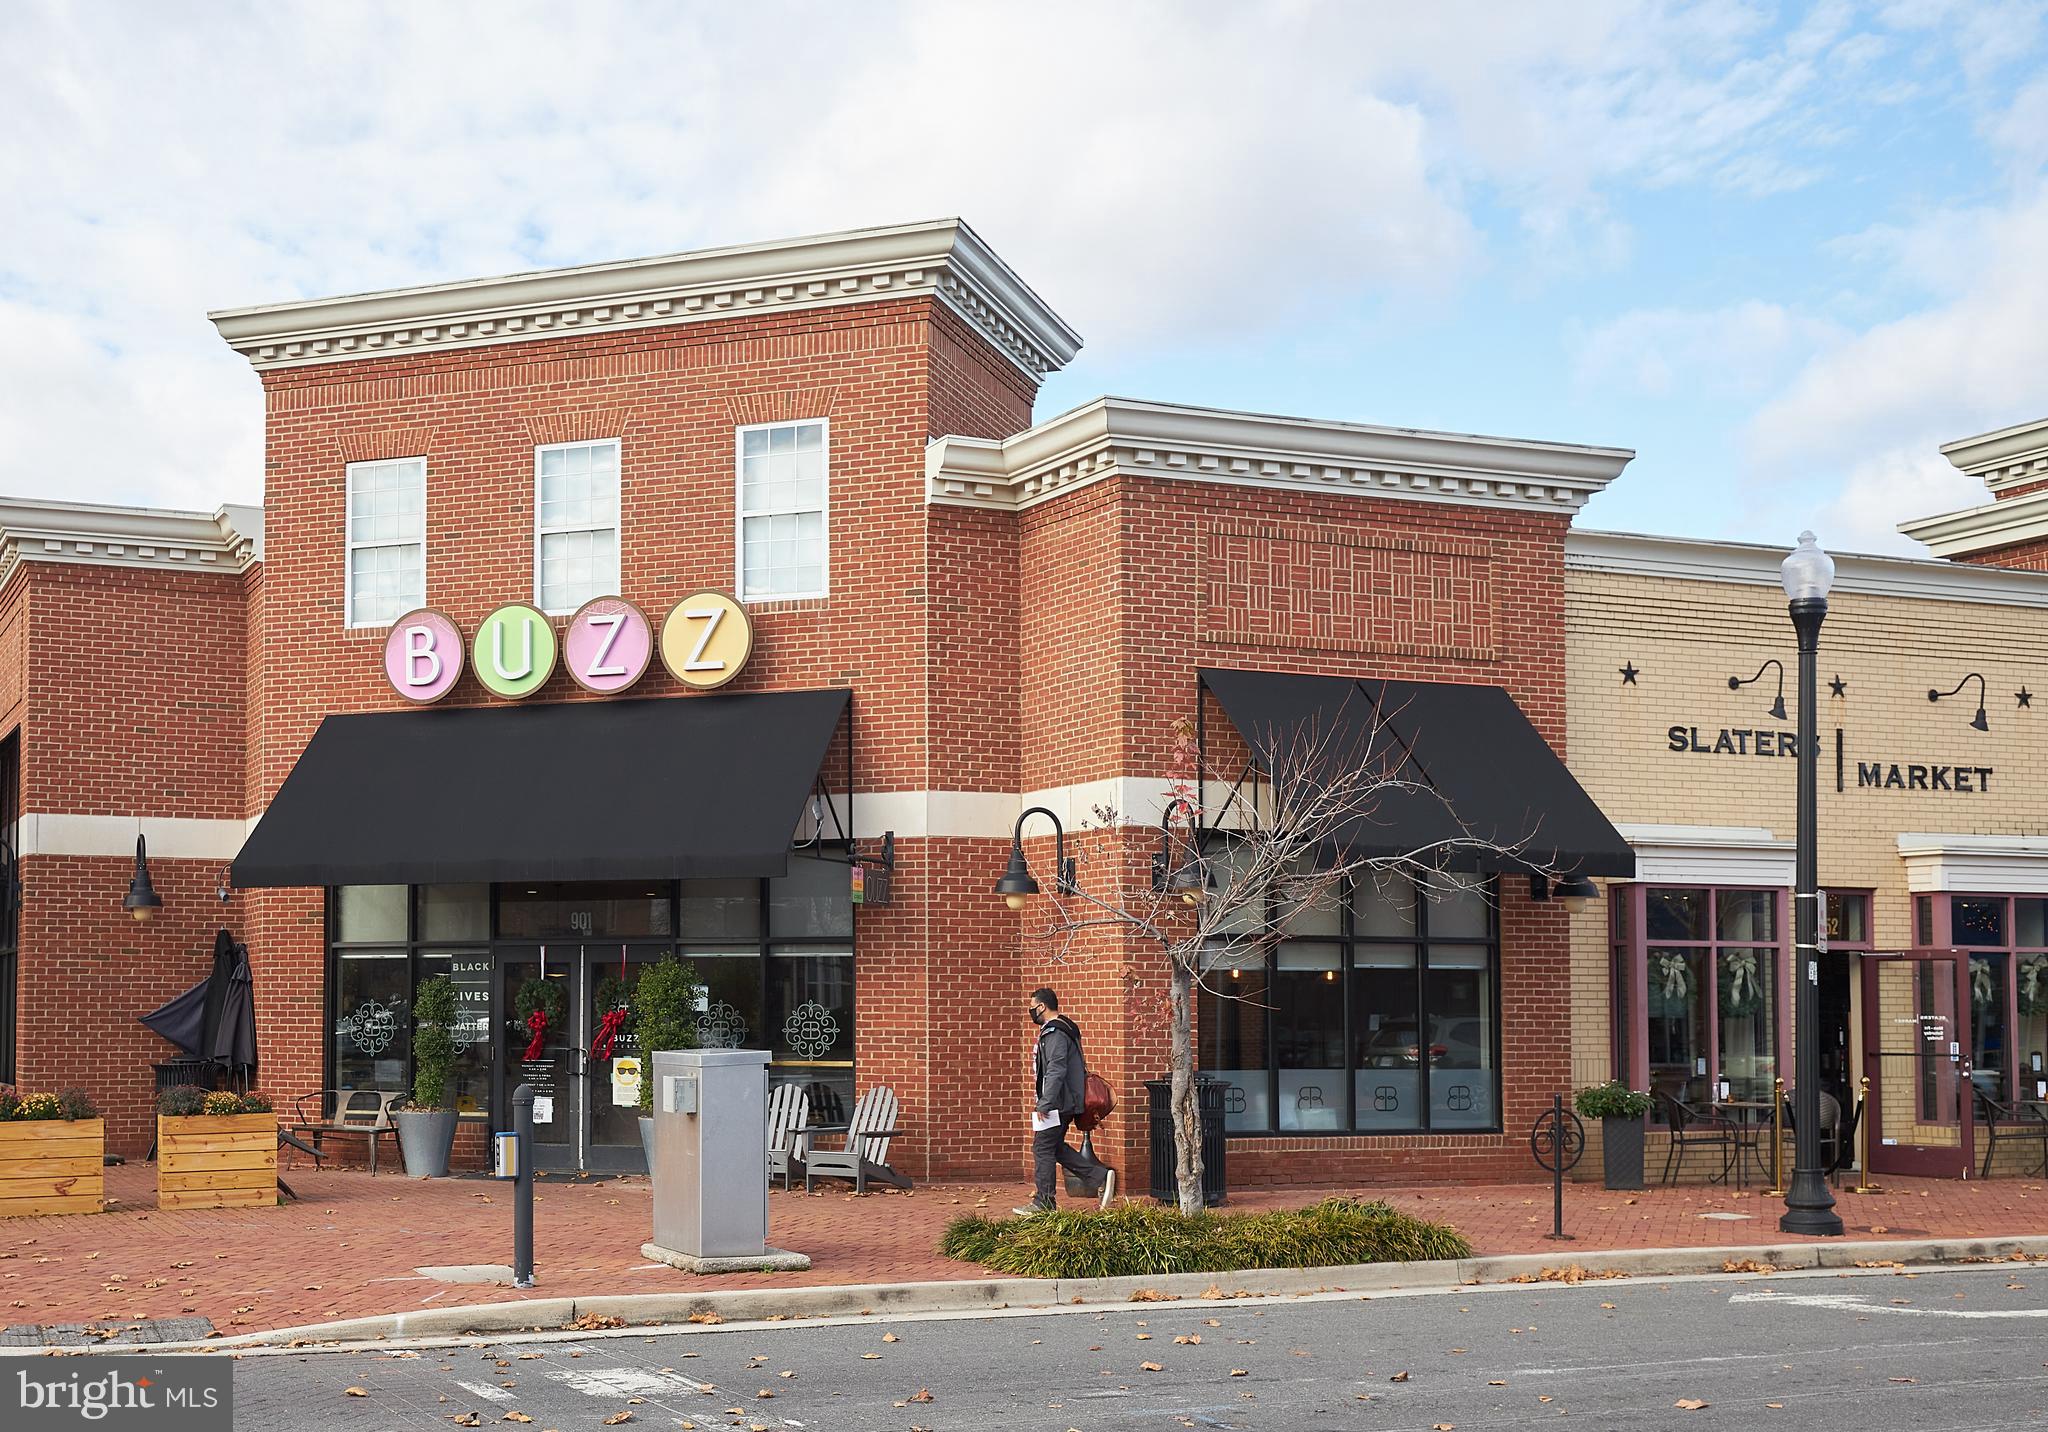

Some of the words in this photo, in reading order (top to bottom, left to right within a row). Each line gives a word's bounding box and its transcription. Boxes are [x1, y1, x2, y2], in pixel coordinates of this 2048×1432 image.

[404, 608, 727, 686] BUZZ
[1668, 726, 1822, 758] SLATER
[1857, 762, 1993, 792] MARKET
[571, 912, 592, 930] 901
[453, 963, 489, 971] BLACK
